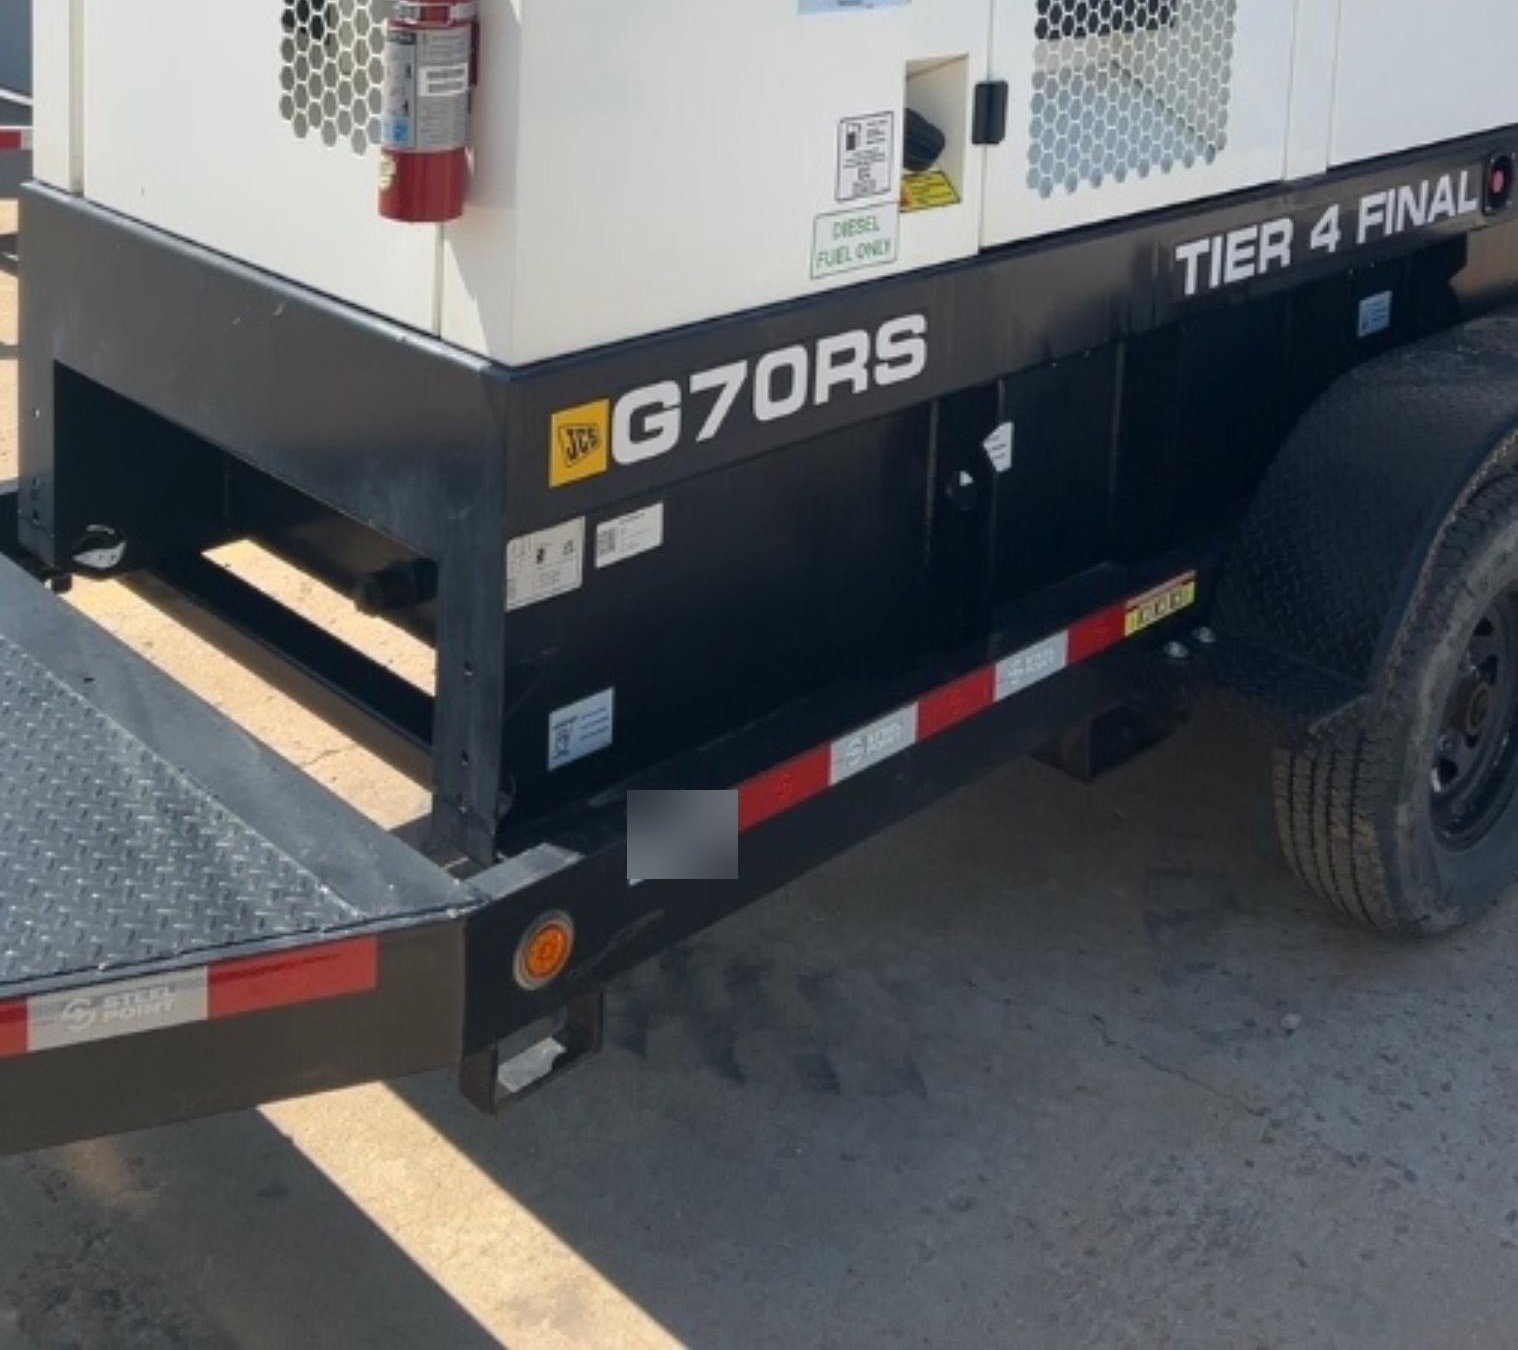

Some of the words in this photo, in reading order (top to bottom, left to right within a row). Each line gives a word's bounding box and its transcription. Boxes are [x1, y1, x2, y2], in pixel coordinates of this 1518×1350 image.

[816, 247, 852, 269] FUEL
[855, 239, 891, 259] ONLY
[833, 215, 880, 240] DIESEL
[1176, 217, 1294, 296] TIER
[1310, 204, 1342, 253] 4
[1356, 170, 1480, 244] FINAL
[612, 314, 928, 466] G70RS
